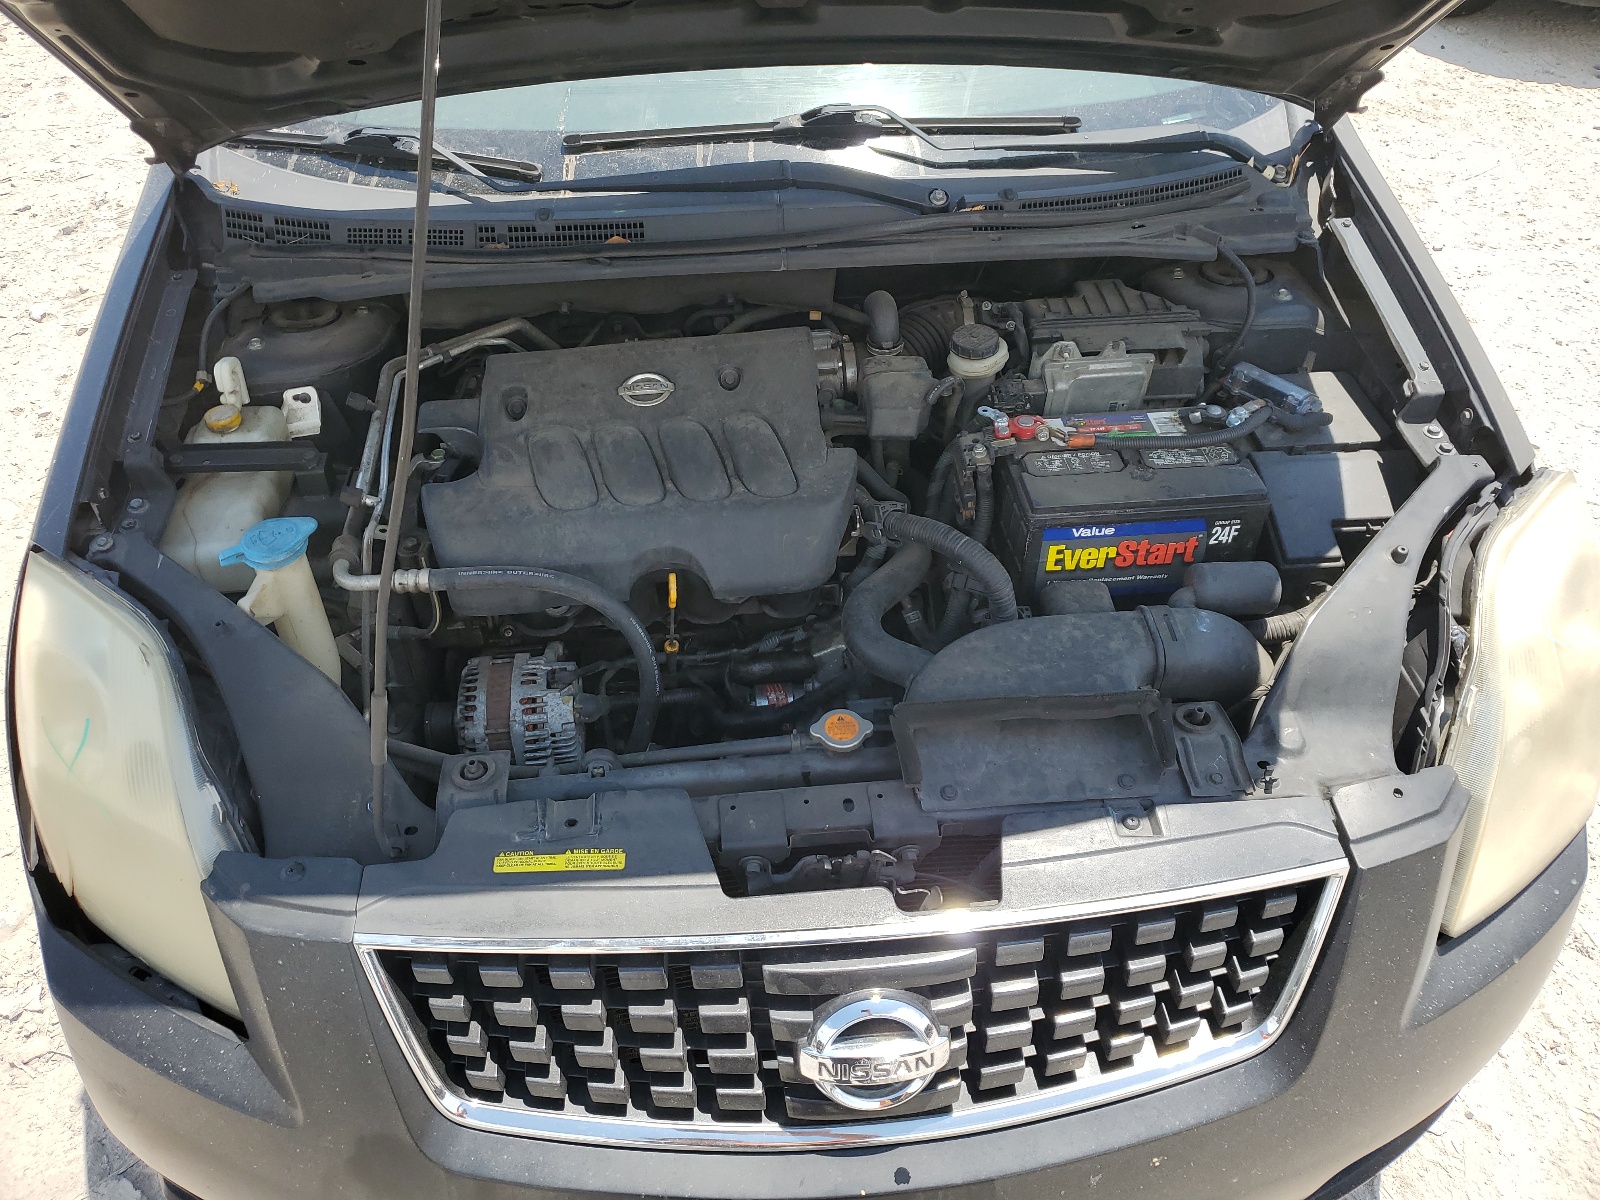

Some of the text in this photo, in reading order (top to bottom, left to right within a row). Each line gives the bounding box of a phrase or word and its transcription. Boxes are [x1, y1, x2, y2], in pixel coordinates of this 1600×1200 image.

[623, 383, 669, 391] NISSAN
[1072, 526, 1116, 537] Value
[1208, 525, 1241, 544] 24F
[1045, 536, 1199, 572] EverStart
[818, 1052, 936, 1081] NISSAN
